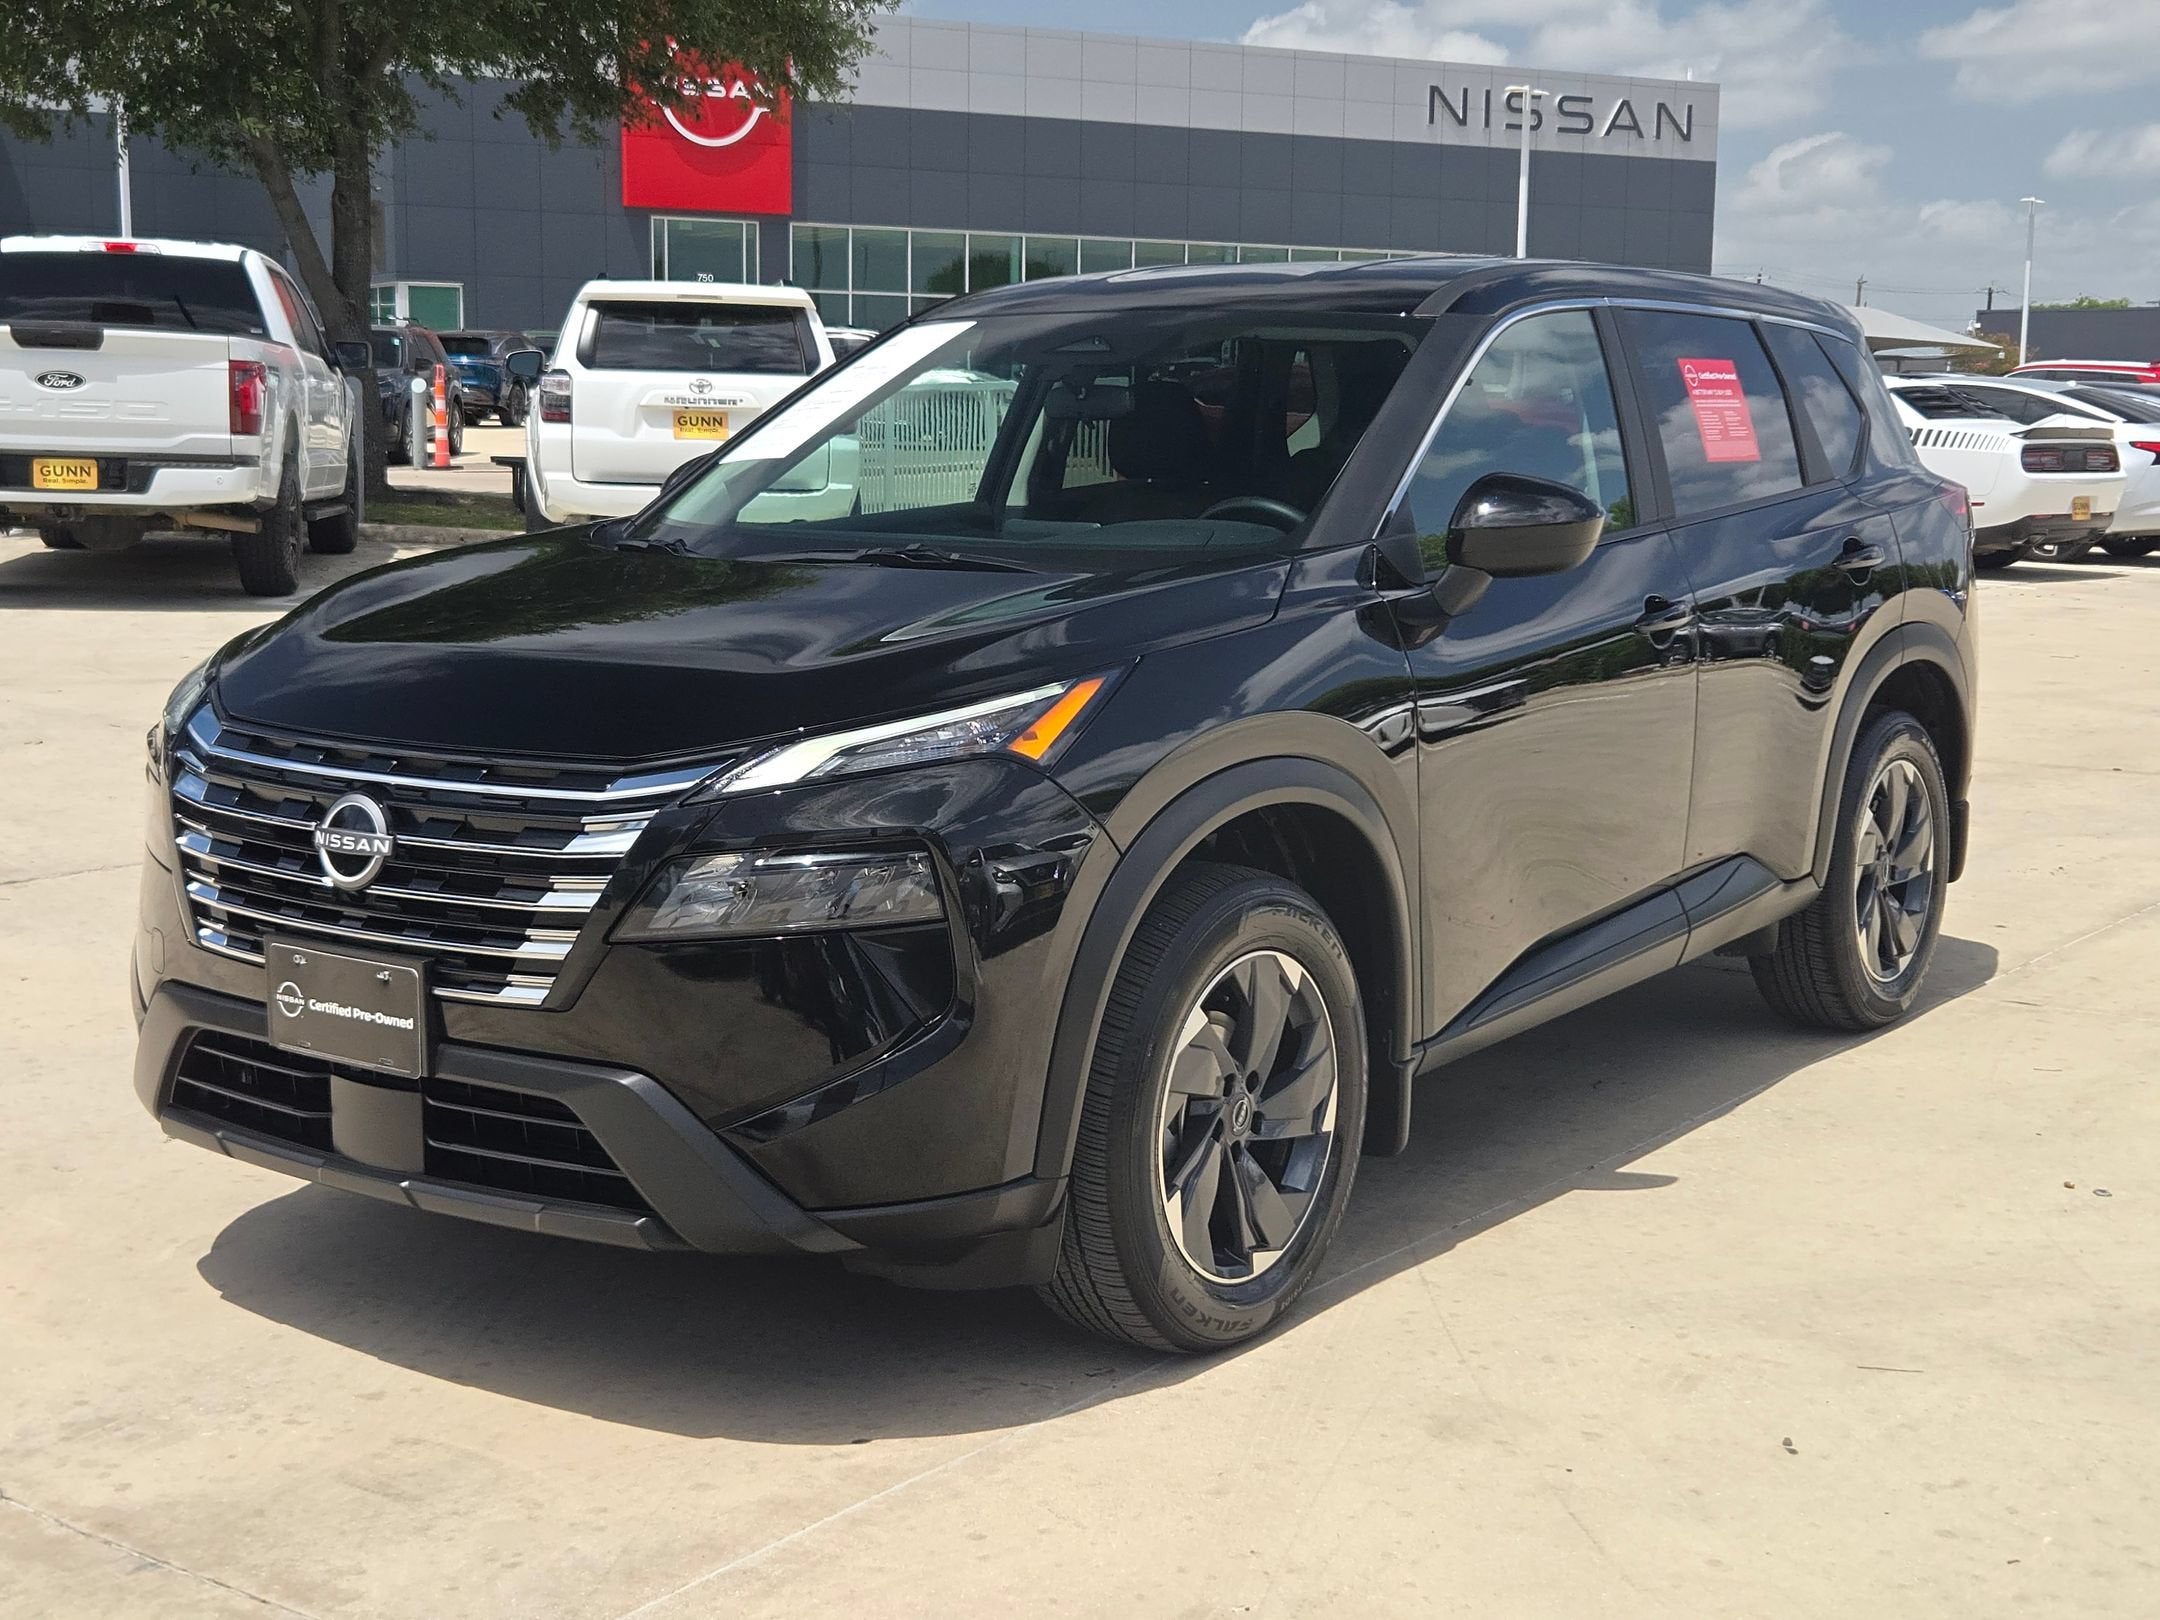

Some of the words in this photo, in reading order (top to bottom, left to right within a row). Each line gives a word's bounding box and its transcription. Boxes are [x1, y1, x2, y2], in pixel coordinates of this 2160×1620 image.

[1428, 85, 1694, 142] NISSAN
[697, 273, 714, 283] 750
[44, 374, 76, 388] Ford
[677, 415, 723, 427] GUNN
[40, 465, 91, 477] GUNN
[315, 830, 390, 853] NISSAN
[276, 993, 305, 1006] NISSAN
[309, 999, 352, 1018] Certified
[353, 1007, 414, 1030] Pre-Owned
